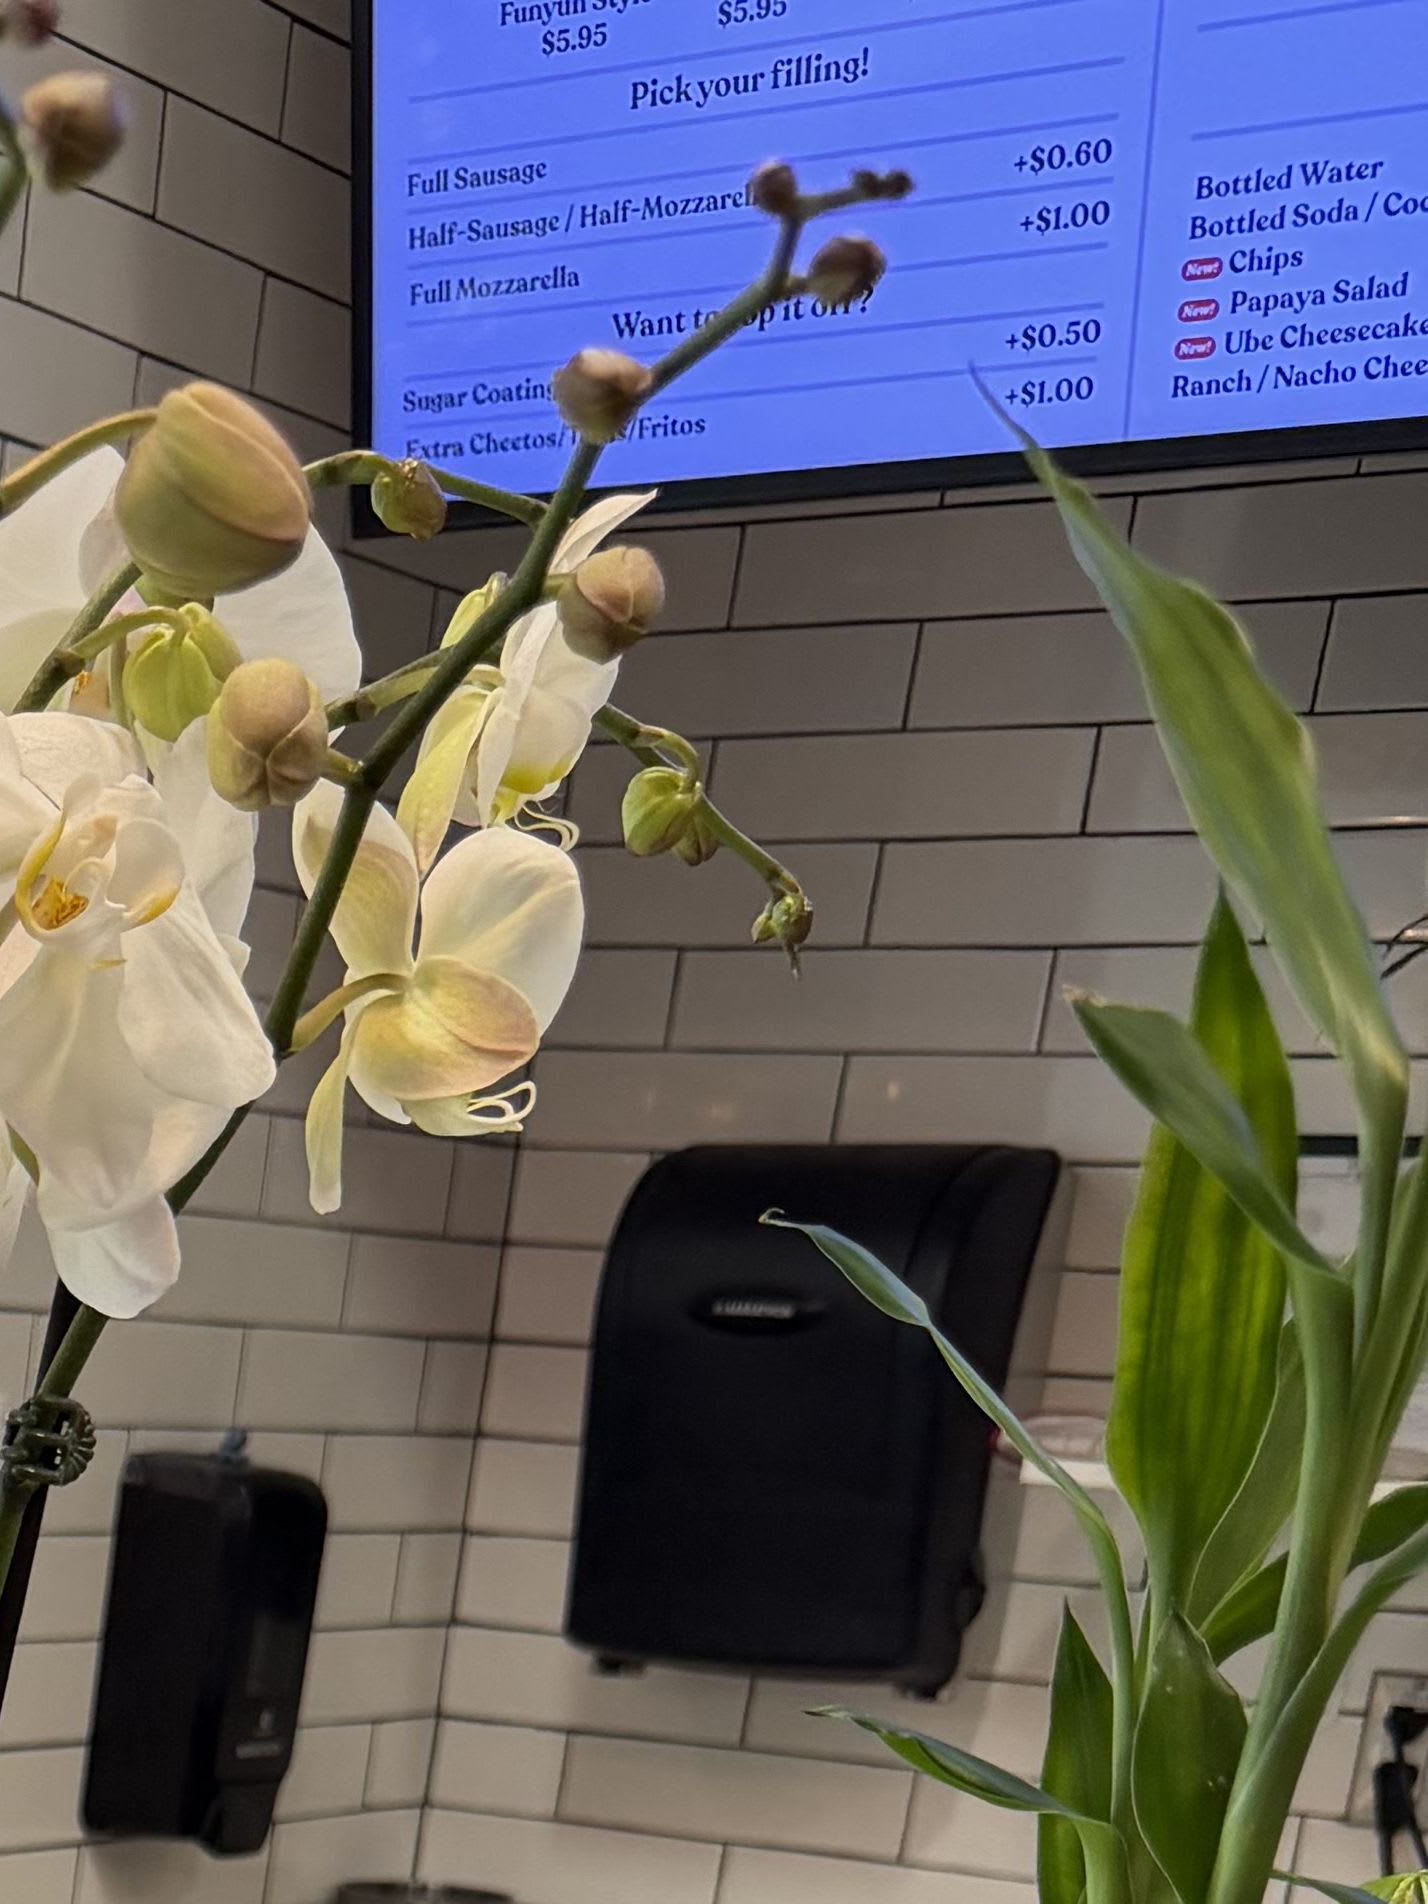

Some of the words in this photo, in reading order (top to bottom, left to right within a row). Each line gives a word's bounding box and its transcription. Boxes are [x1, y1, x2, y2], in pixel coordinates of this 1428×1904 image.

[500, 0, 587, 26] Funyun
[718, 0, 787, 27] $5.95
[542, 23, 607, 56] $5.95
[630, 74, 693, 110] Pick
[695, 72, 765, 108] your
[770, 47, 869, 89] filling!
[1014, 138, 1113, 176] +$0.60
[407, 169, 449, 197] Full
[454, 162, 547, 190] Sausage
[1195, 164, 1293, 200] Bottled
[1300, 159, 1384, 187] Water
[408, 214, 560, 250] Half-Sausage
[564, 204, 575, 233] /
[580, 183, 757, 229] Half-Mozzarel
[1020, 200, 1110, 236] +$1.00
[1189, 205, 1286, 240] Bottled
[1292, 198, 1359, 228] Soda
[1364, 191, 1379, 223] /
[1229, 246, 1304, 276] Chips
[410, 279, 451, 306] Full
[455, 265, 580, 300] Mozzarella
[1230, 288, 1326, 318] Papaya
[1332, 272, 1409, 304] Salad
[612, 310, 686, 339] Want
[1005, 318, 1101, 352] +$0.50
[1225, 329, 1274, 355] Ube
[1280, 313, 1428, 349] Cheesecake
[1005, 375, 1093, 408] +$1.00
[1171, 369, 1252, 398] Ranch
[1256, 365, 1270, 394] /
[1273, 360, 1357, 389] Nacho
[402, 388, 468, 413] Sugar
[406, 438, 465, 460] Extra
